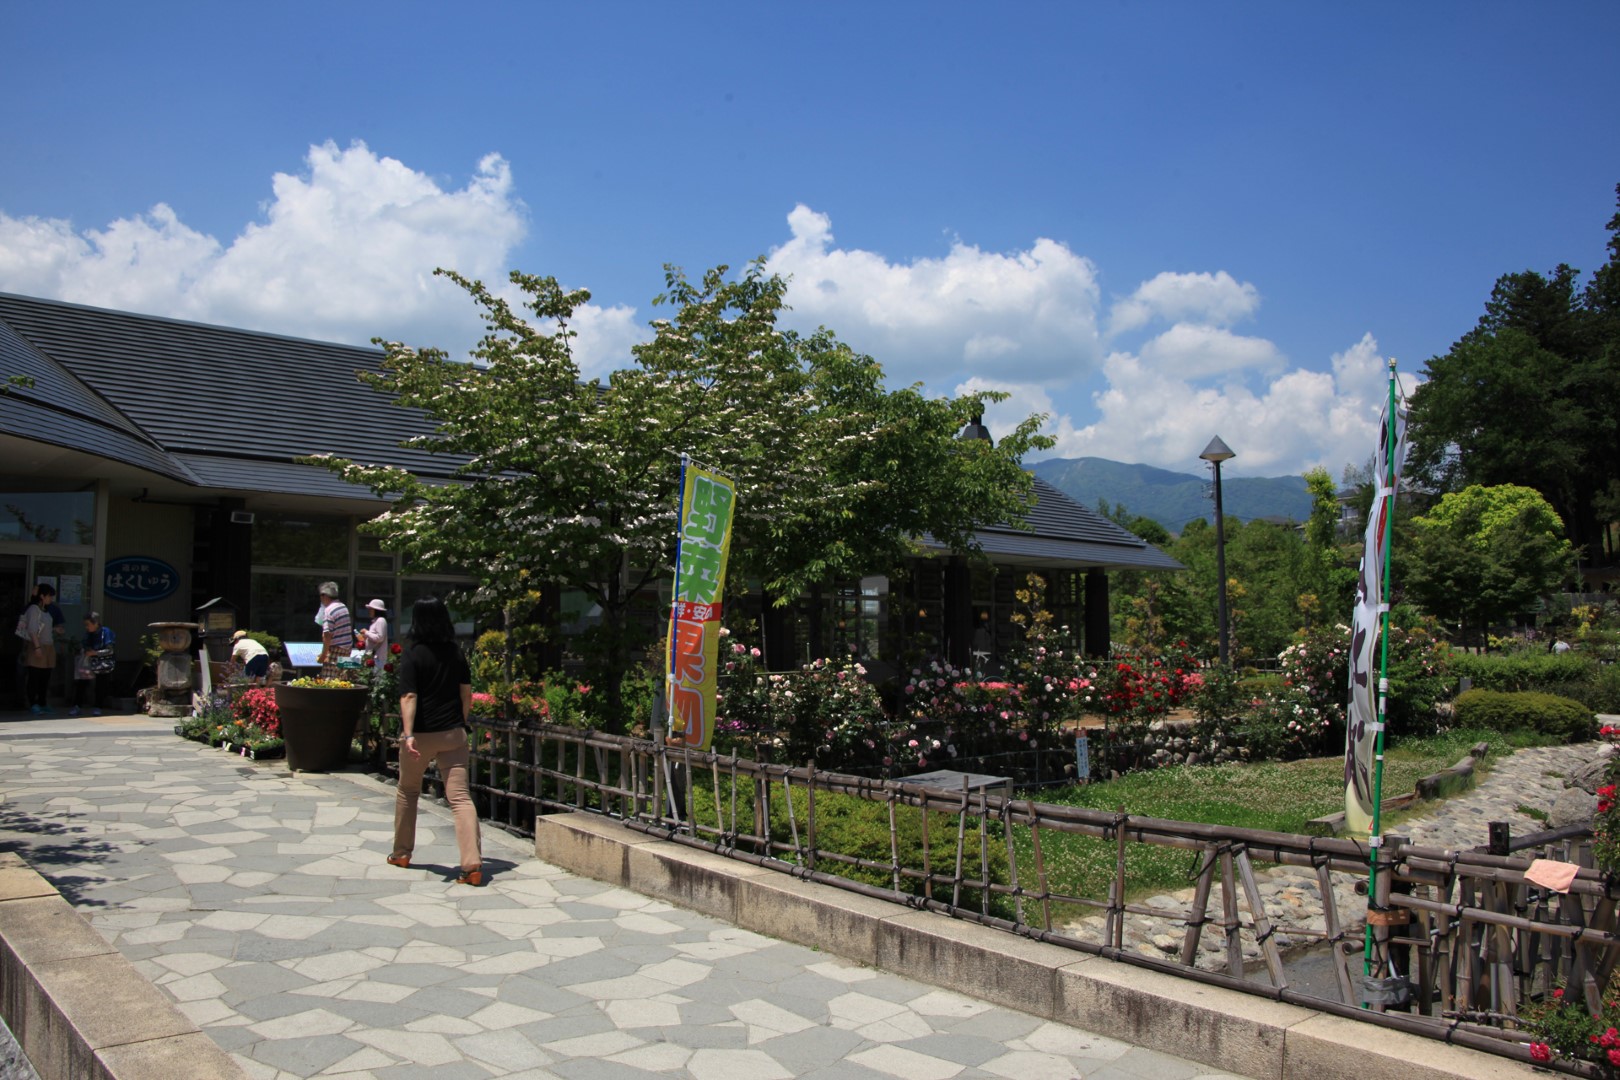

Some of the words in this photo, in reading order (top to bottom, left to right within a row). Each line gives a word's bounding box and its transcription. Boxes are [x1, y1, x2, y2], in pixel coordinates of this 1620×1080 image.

[678, 475, 733, 605] 野菜
[106, 572, 171, 592] はくしゅう
